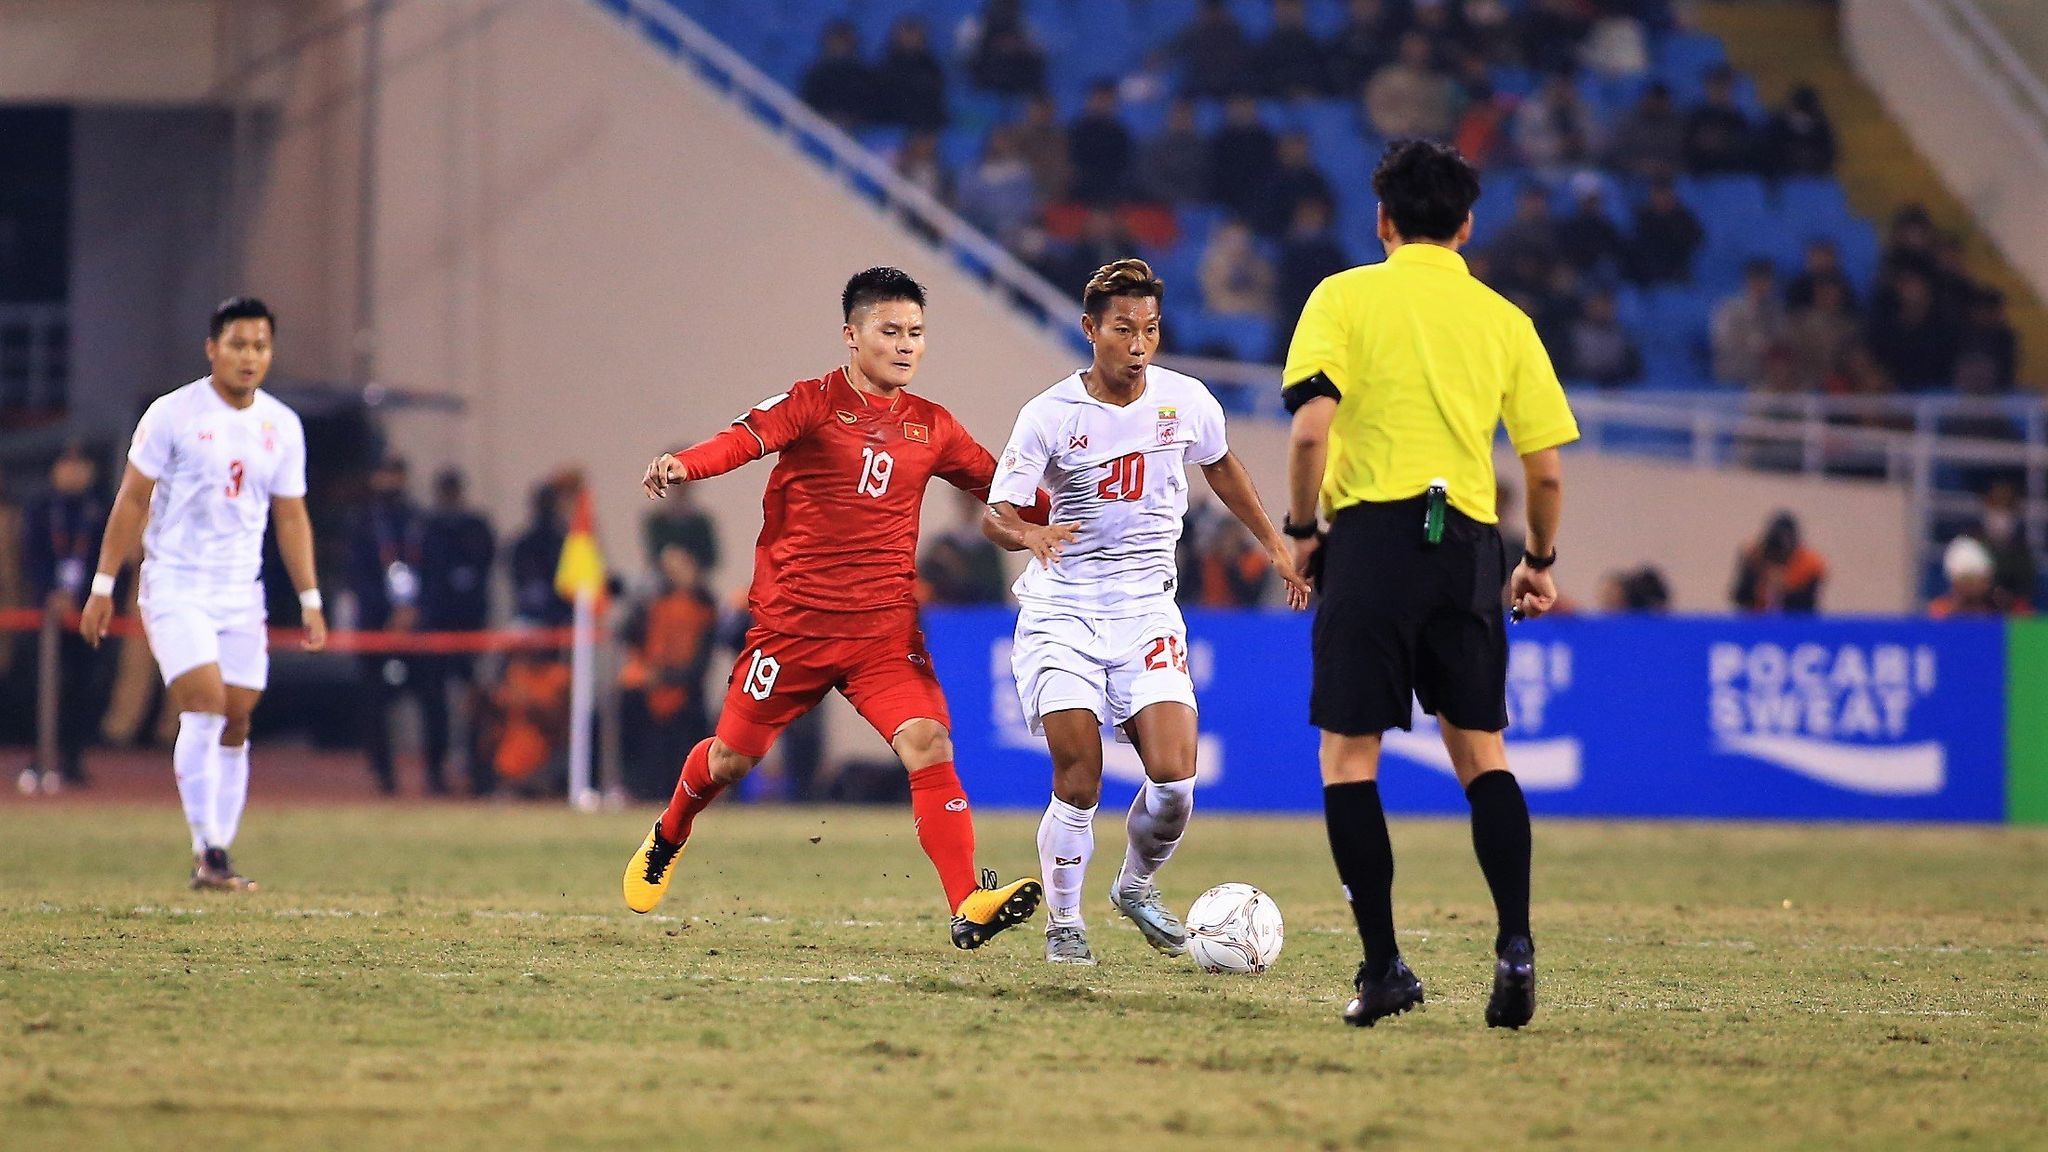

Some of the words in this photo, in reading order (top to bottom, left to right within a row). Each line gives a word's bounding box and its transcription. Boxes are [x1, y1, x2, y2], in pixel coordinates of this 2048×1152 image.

[225, 459, 244, 498] 3
[857, 446, 894, 498] 19
[1097, 451, 1145, 500] 20
[742, 648, 781, 701] 19
[1709, 643, 1936, 692] POCARI
[1709, 687, 1911, 736] SWEAT
